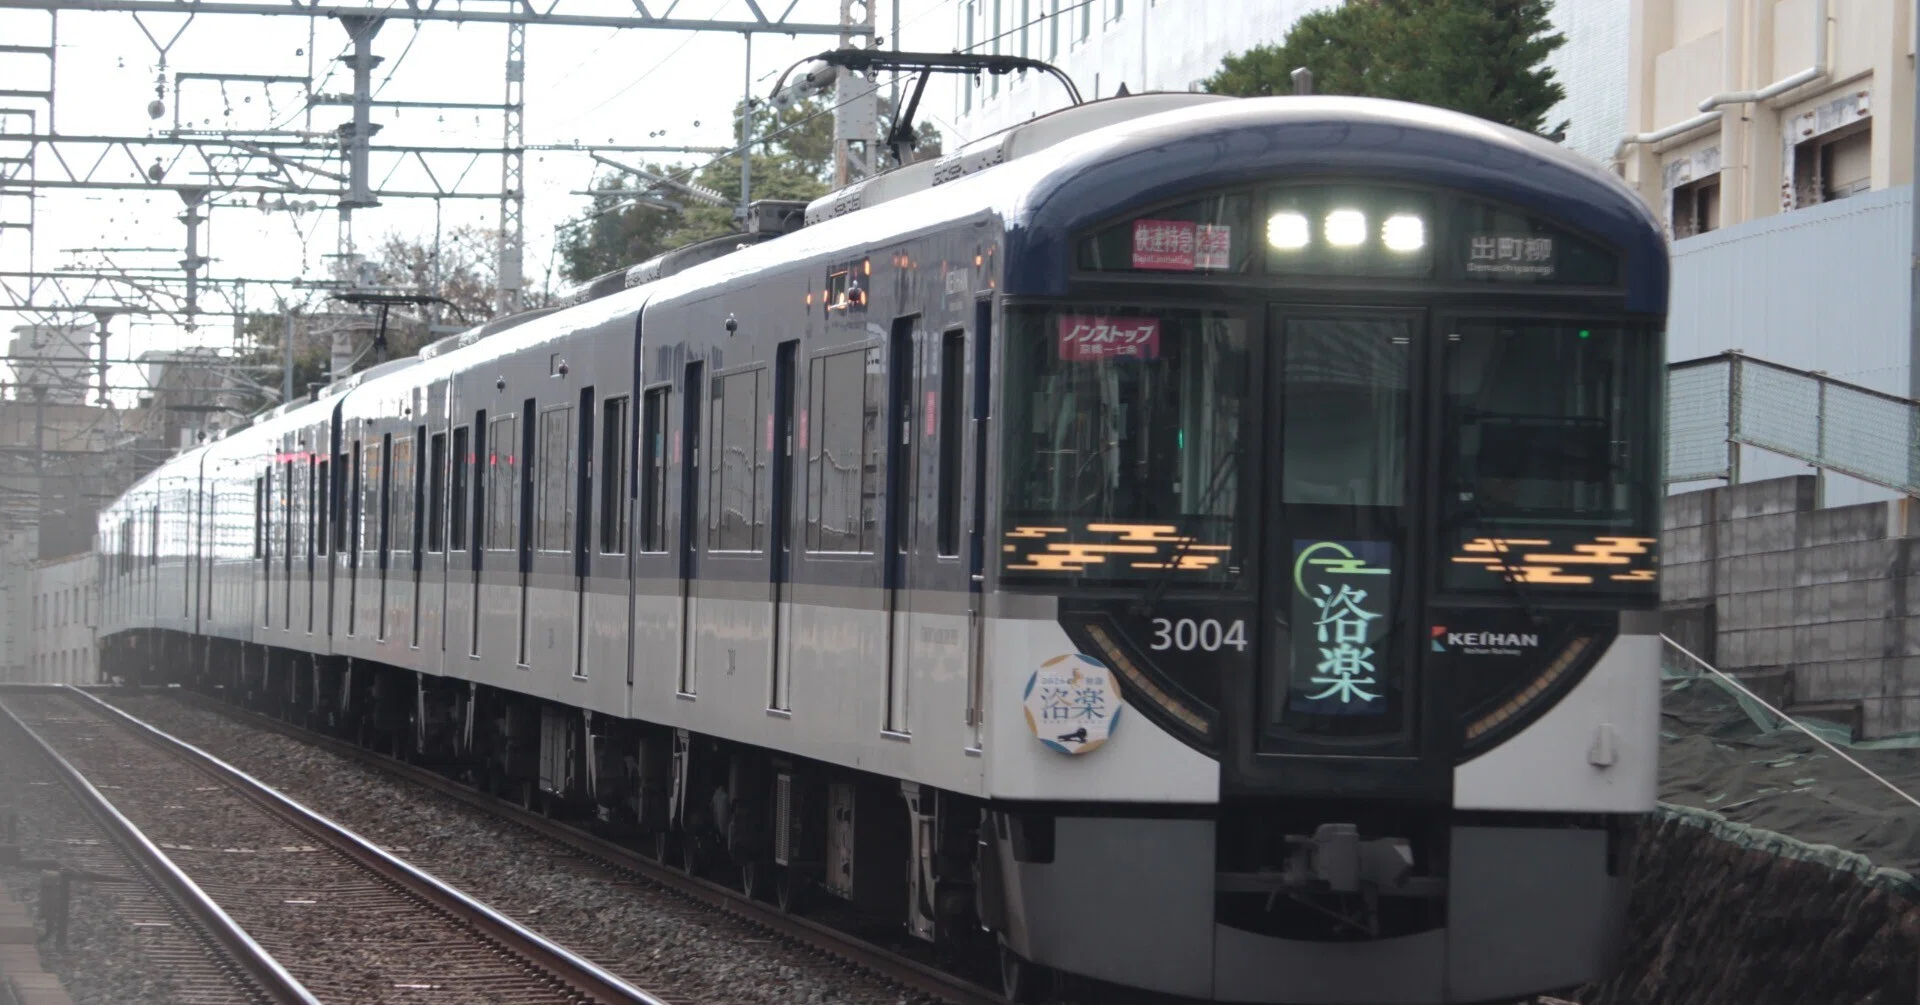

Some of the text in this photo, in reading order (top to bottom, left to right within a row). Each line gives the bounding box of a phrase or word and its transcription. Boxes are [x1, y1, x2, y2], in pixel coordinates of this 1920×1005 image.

[1134, 225, 1193, 253] 快速特急
[1470, 237, 1552, 261] 出町柳
[1063, 325, 1155, 343] ノンストップ
[1150, 617, 1247, 651] 3004
[1305, 584, 1384, 703] 洛楽
[1447, 631, 1538, 647] KEIHAN
[1041, 687, 1106, 720] 洛楽
